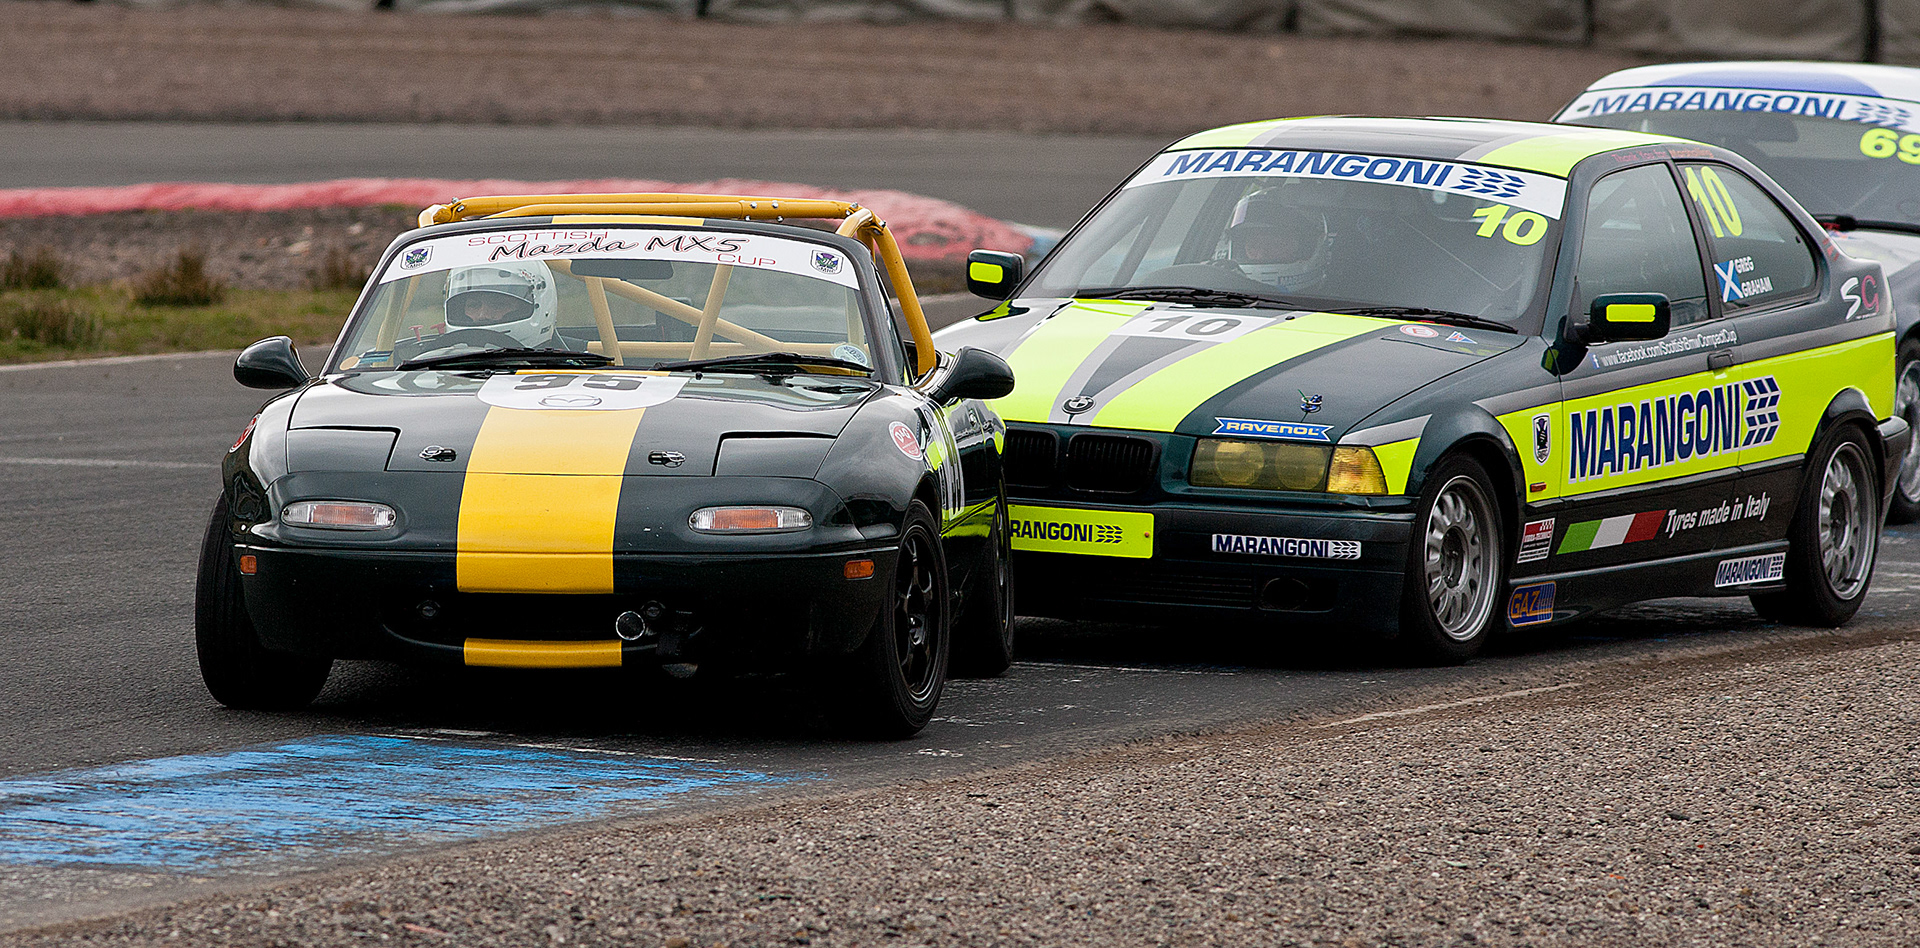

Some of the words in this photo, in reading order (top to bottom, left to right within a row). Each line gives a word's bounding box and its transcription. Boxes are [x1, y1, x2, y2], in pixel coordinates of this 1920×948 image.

[1590, 91, 1848, 119] MARANGONI
[1859, 127, 1920, 165] 69
[1163, 150, 1454, 187] MARANGONI
[1684, 165, 1743, 238] 10
[1472, 203, 1549, 246] 10
[468, 231, 609, 247] SCOTTISH
[487, 235, 640, 262] Mazda
[644, 234, 750, 254] MX5
[717, 253, 776, 266] CUP
[1734, 255, 1755, 274] GREG
[1741, 276, 1774, 297] GRAHAM
[1148, 315, 1242, 336] 10
[513, 374, 648, 391] 95
[1226, 422, 1320, 436] RAVENOL
[1568, 382, 1742, 481] MARANGONI
[1665, 509, 1698, 539] Tyres
[1697, 500, 1731, 527] made
[1731, 497, 1744, 521] in
[1744, 491, 1771, 521] Italy
[1010, 519, 1093, 542] RANGONI
[1216, 535, 1329, 558] MARANGONI
[1715, 557, 1772, 585] MARANGONI
[1510, 590, 1541, 619] GAZ
